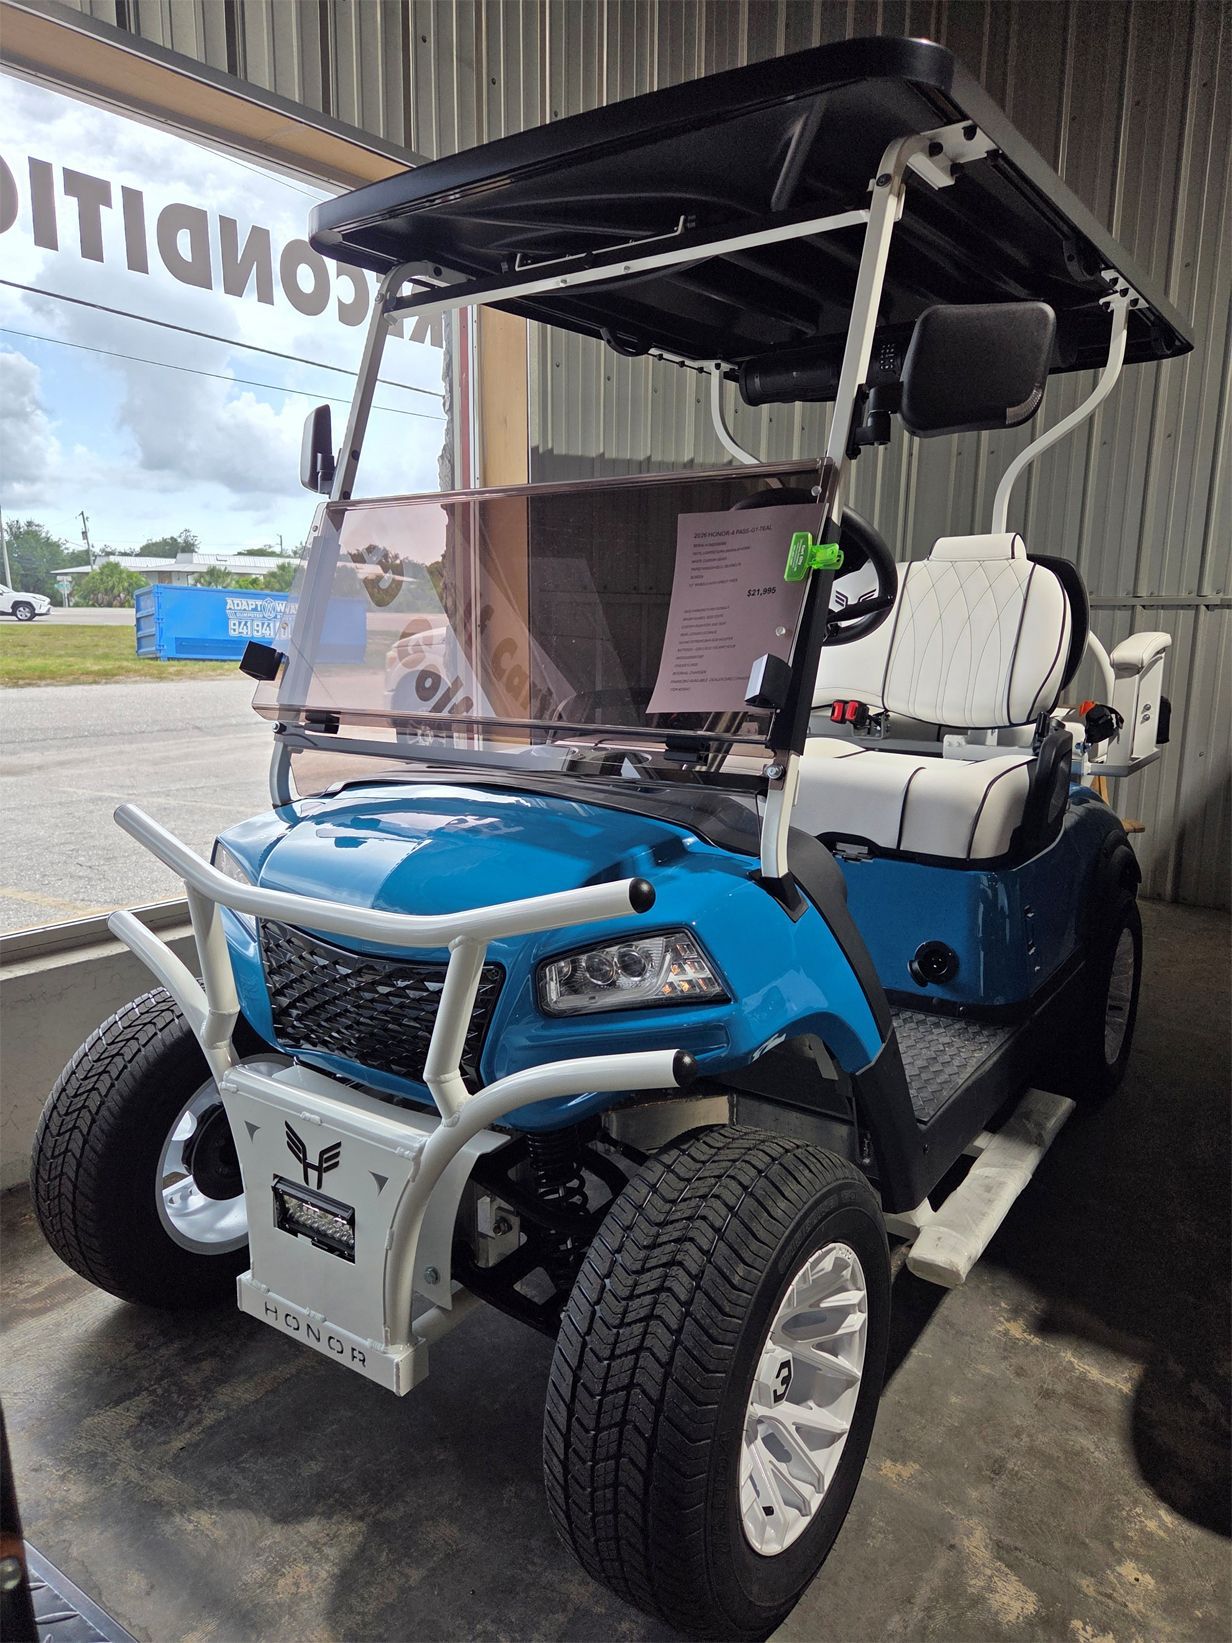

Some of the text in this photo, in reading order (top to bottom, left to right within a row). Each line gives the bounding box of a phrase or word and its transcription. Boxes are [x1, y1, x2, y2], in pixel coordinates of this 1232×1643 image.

[747, 586, 777, 597] $21,995
[226, 599, 262, 611] ADAPT
[229, 619, 251, 636] 941
[253, 620, 274, 637] 941
[264, 1301, 367, 1368] HONOR
